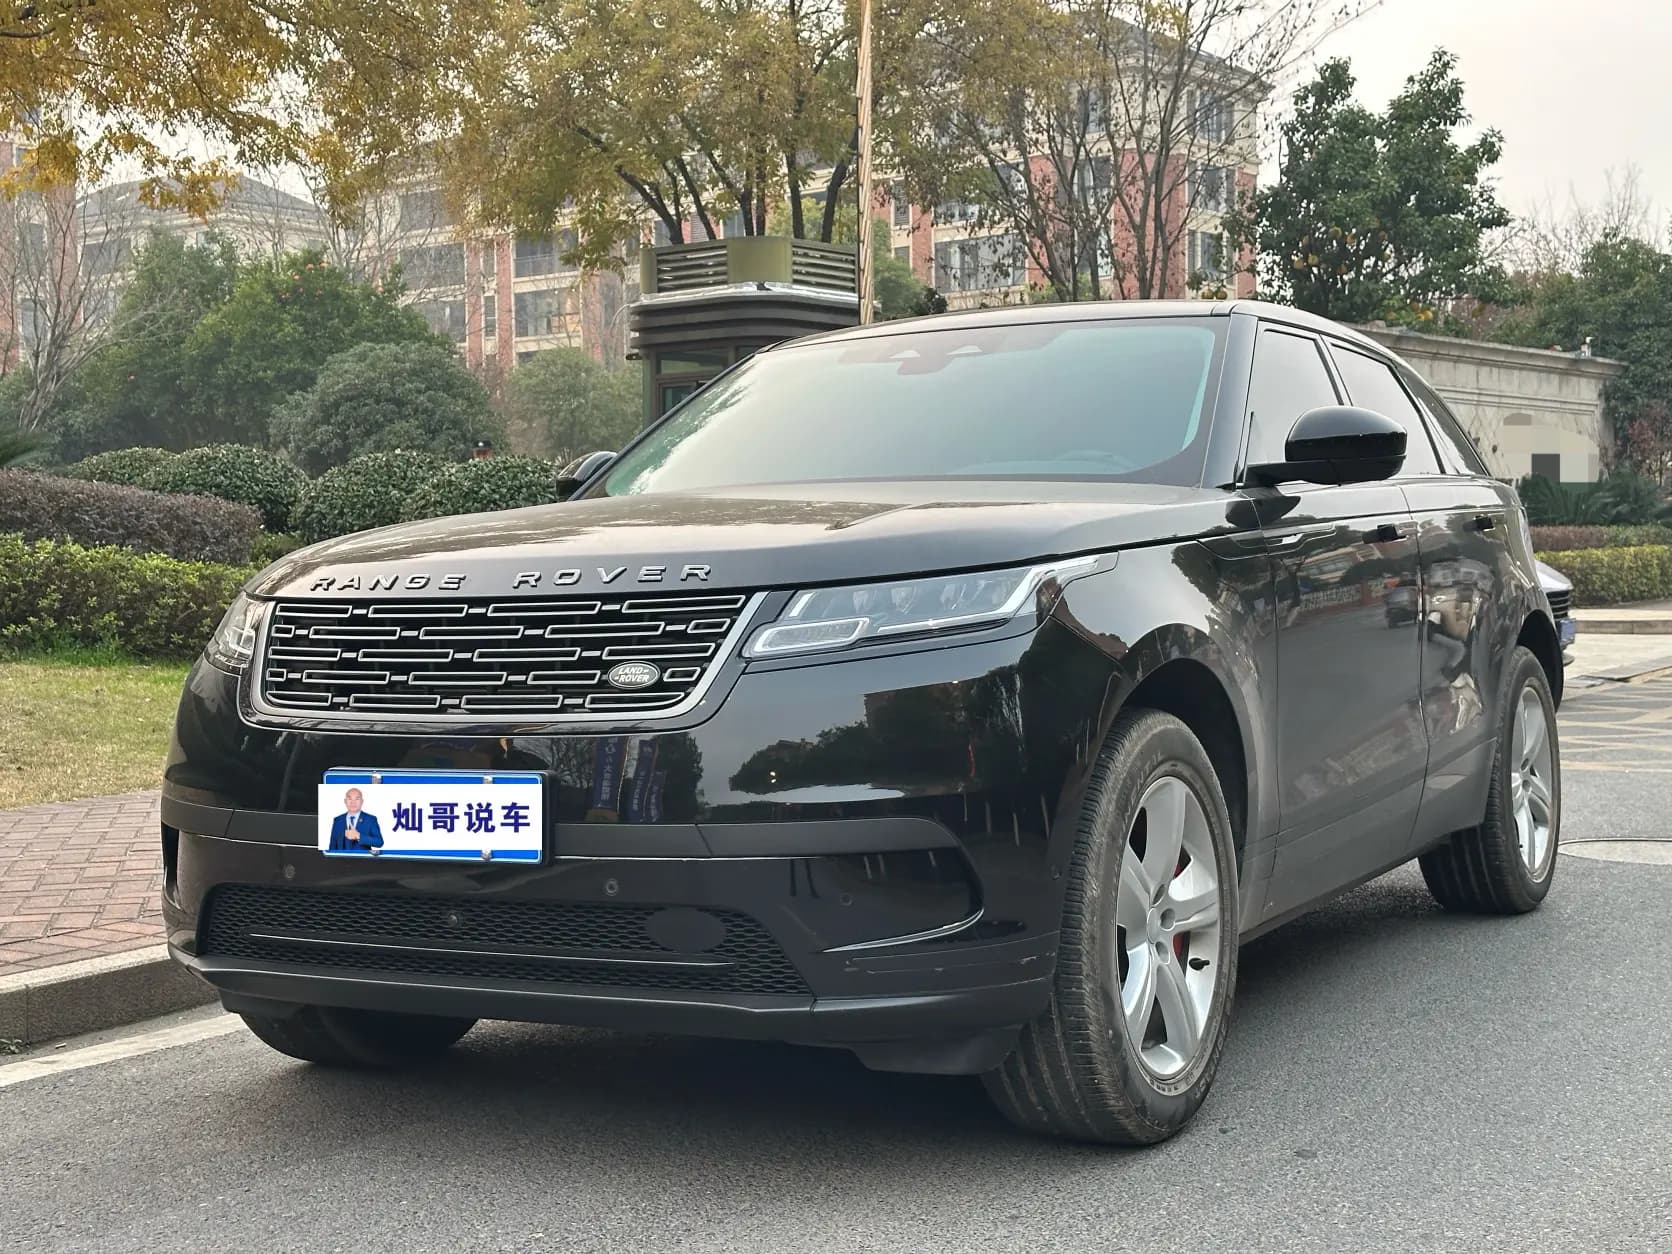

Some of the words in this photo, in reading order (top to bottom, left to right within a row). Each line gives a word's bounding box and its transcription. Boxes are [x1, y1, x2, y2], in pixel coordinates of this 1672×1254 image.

[310, 573, 467, 592] RANGE
[512, 564, 712, 589] ROVER
[618, 666, 644, 675] LAND
[618, 674, 650, 683] ROVER
